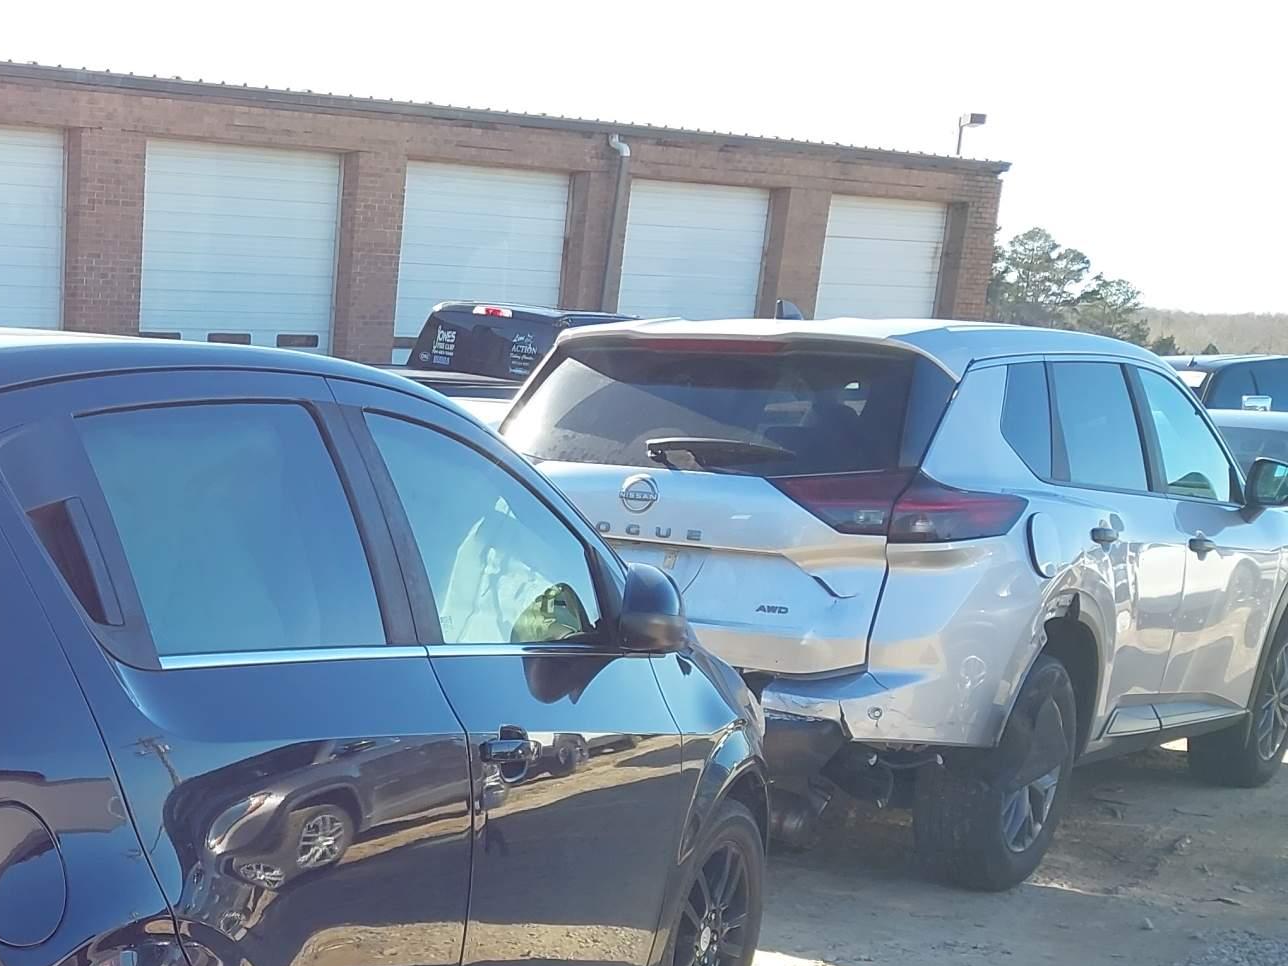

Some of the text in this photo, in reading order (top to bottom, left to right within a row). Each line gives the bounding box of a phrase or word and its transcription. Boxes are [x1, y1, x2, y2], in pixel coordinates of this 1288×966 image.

[511, 344, 537, 355] ACTION
[619, 490, 659, 501] NISSAN
[596, 521, 702, 541] OGUE
[755, 604, 789, 615] AWD
